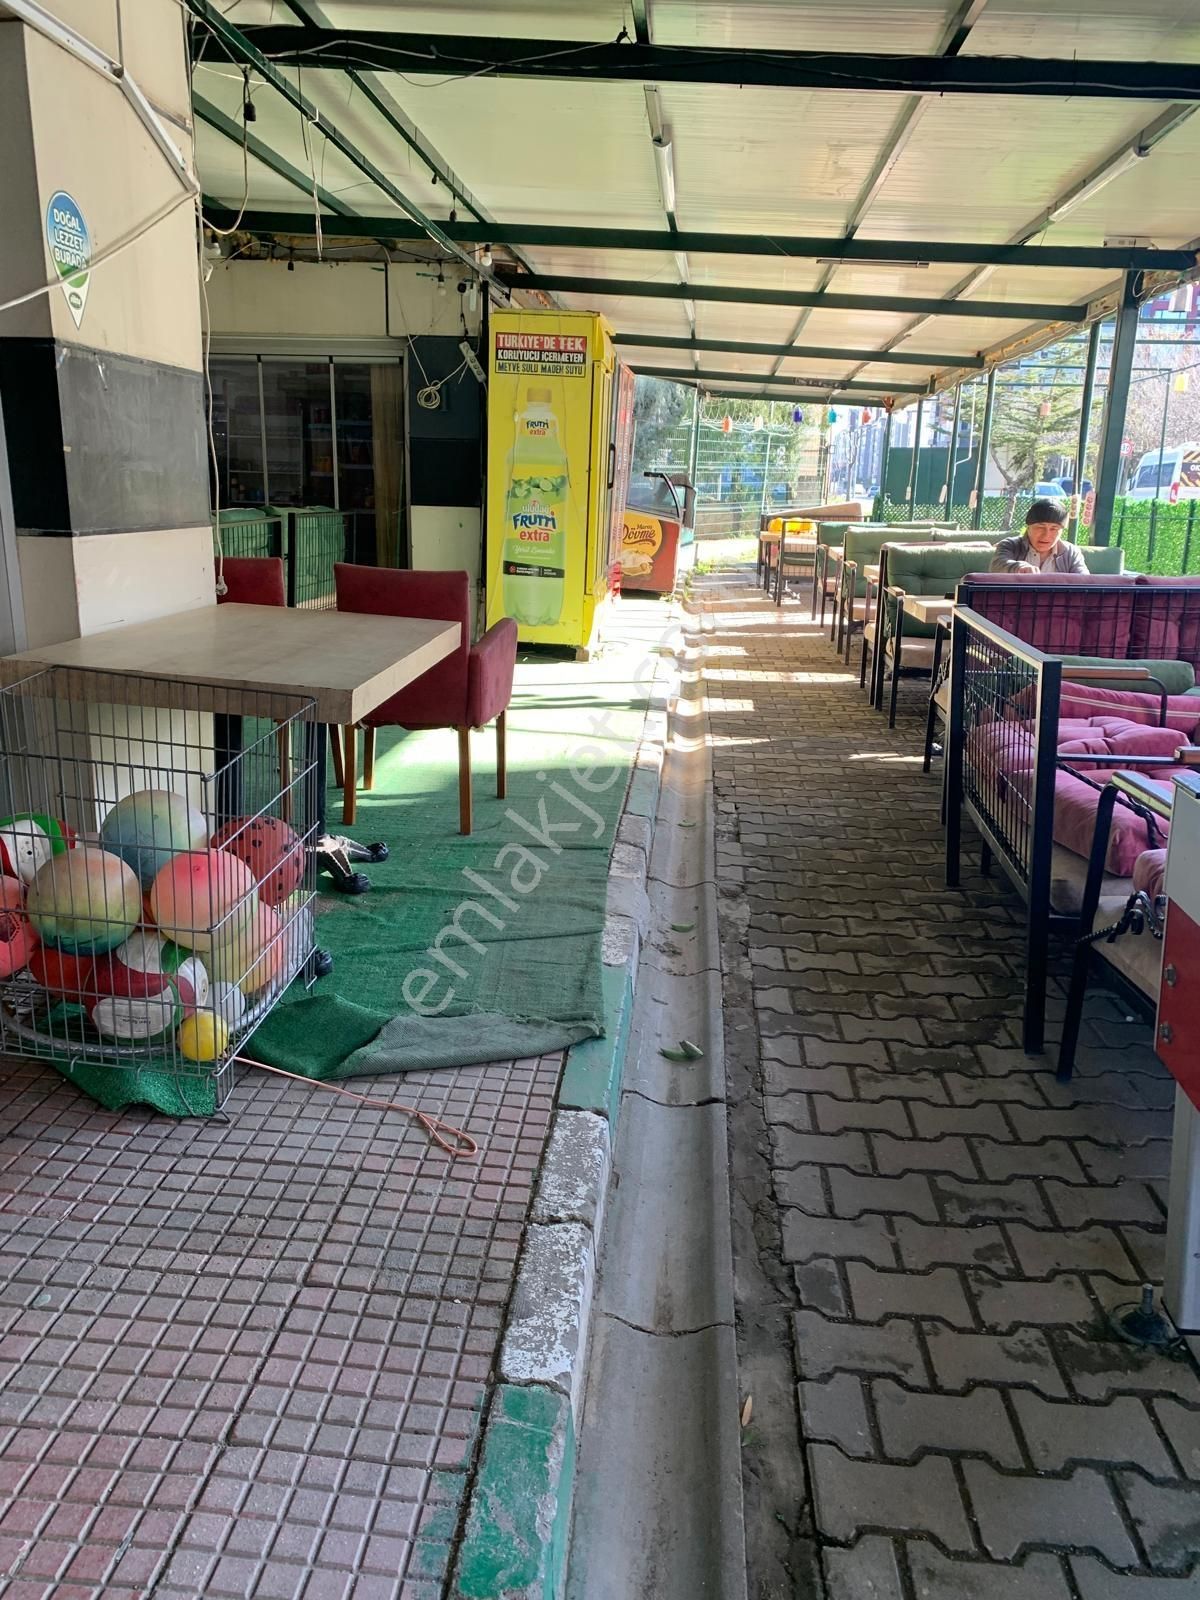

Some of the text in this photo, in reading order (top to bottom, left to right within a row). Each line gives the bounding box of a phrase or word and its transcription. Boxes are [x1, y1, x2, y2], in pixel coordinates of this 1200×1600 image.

[53, 208, 81, 232] DOĞAL
[54, 227, 84, 252] LEZZET
[54, 246, 87, 271] BURADA
[559, 336, 584, 350] TEK
[497, 349, 540, 361] KORUYUCU
[497, 362, 520, 372] MEYVE
[521, 363, 539, 373] SULU
[519, 530, 550, 542] extra
